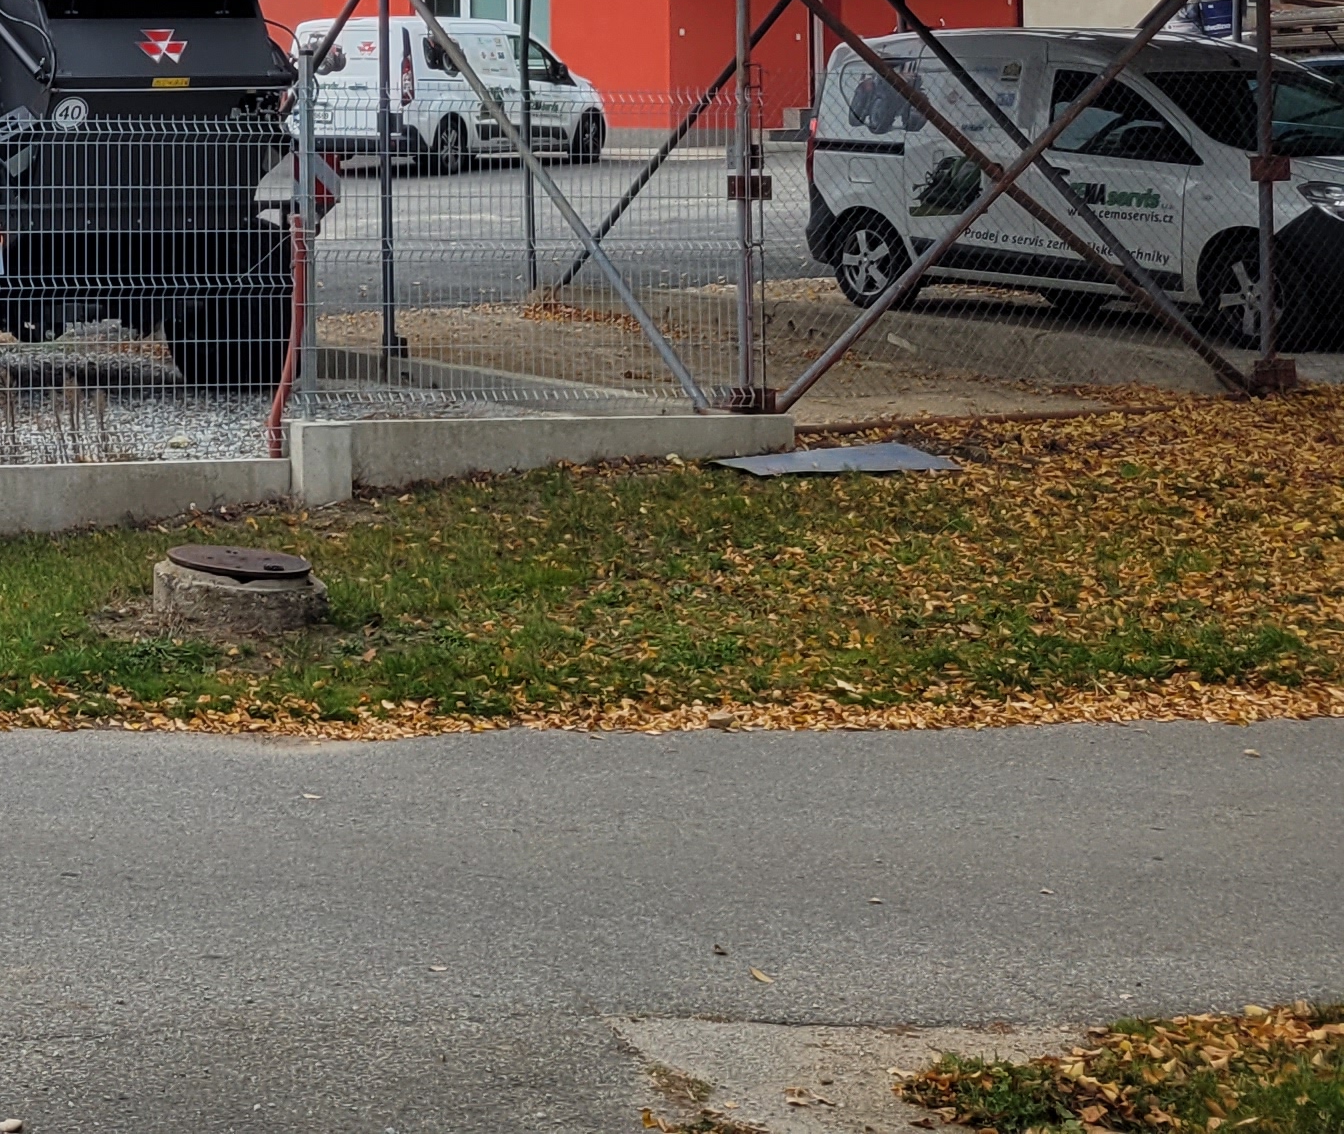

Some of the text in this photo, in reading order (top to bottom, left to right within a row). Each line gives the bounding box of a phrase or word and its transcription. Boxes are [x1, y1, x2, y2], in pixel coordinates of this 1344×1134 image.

[58, 105, 82, 120] 40
[964, 227, 1000, 243] Prodej
[1012, 234, 1044, 247] servis
